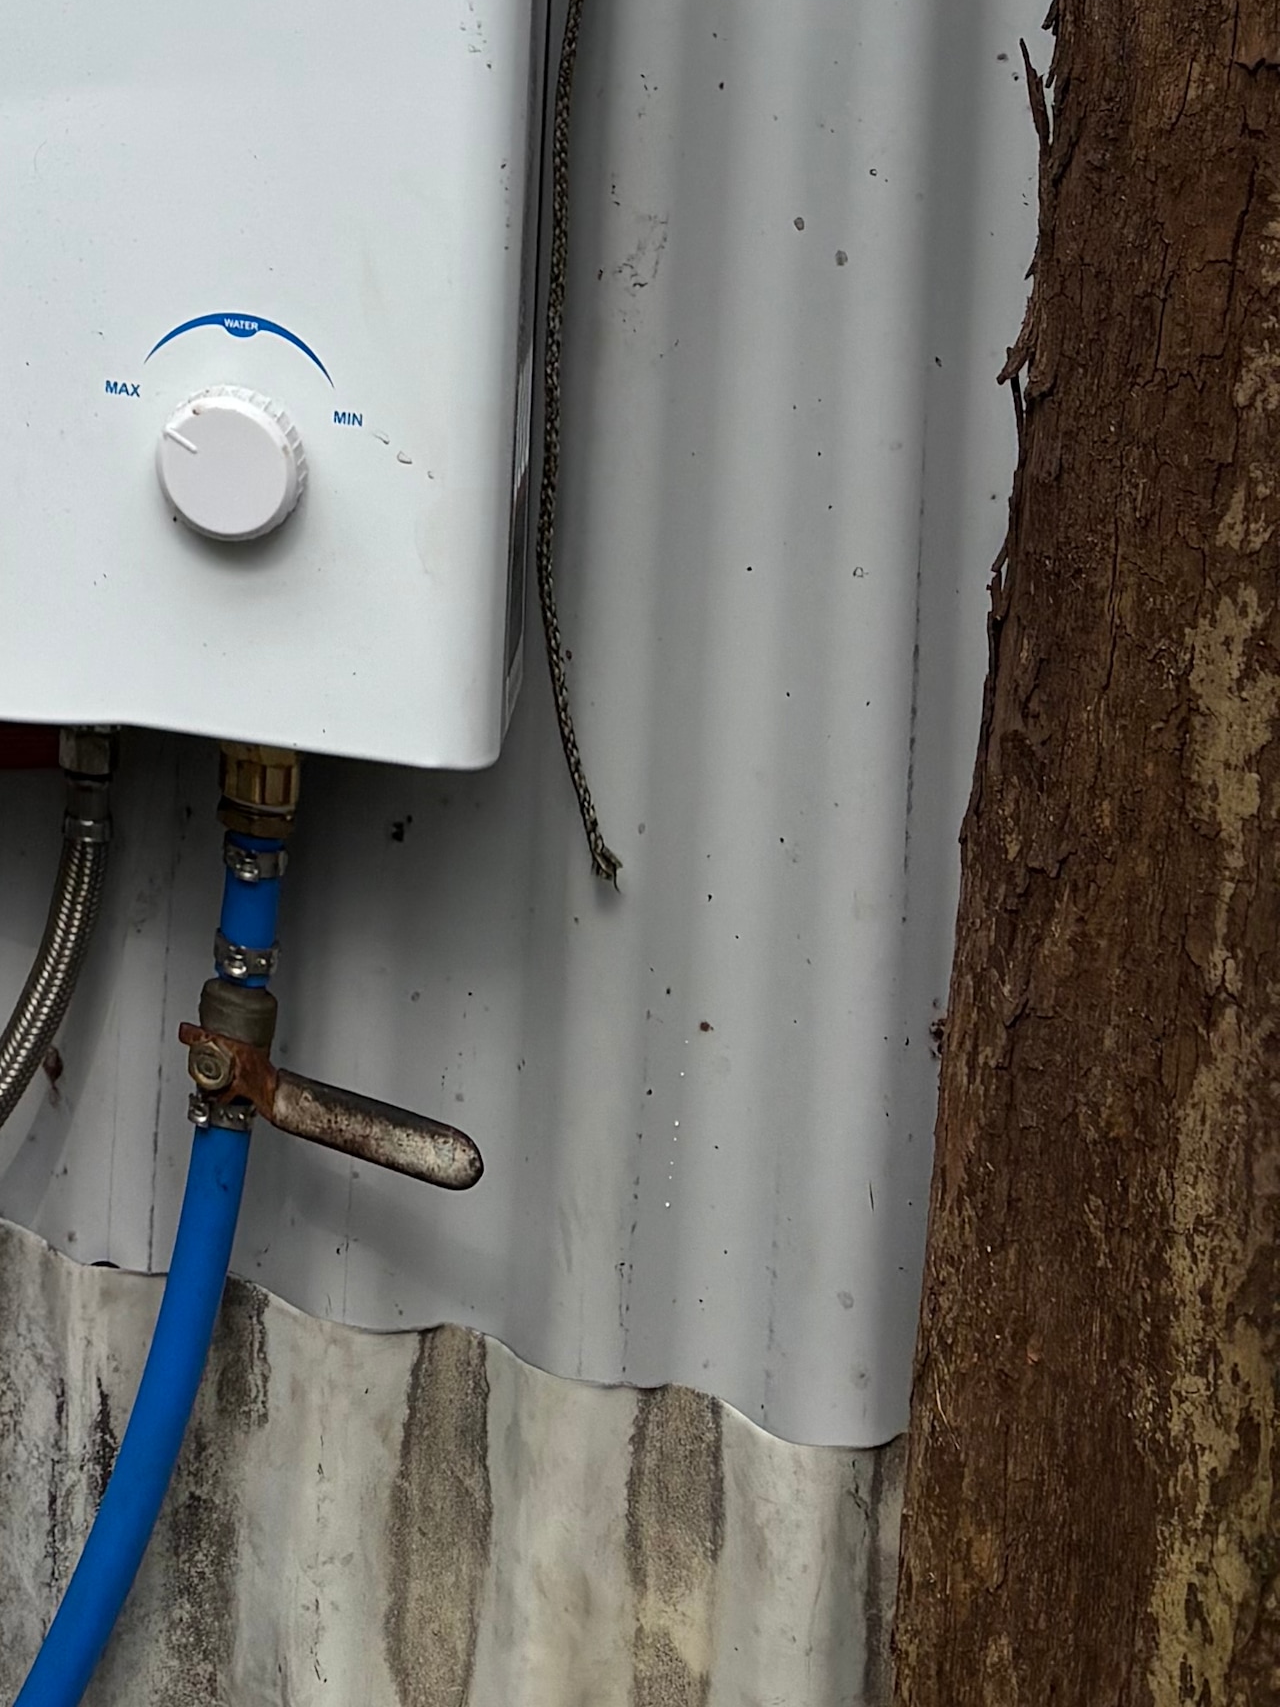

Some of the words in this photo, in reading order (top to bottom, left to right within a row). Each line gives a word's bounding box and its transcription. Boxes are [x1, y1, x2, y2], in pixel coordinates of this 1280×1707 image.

[223, 317, 259, 332] WATER
[105, 379, 141, 398] MAX
[333, 410, 363, 427] MIN
